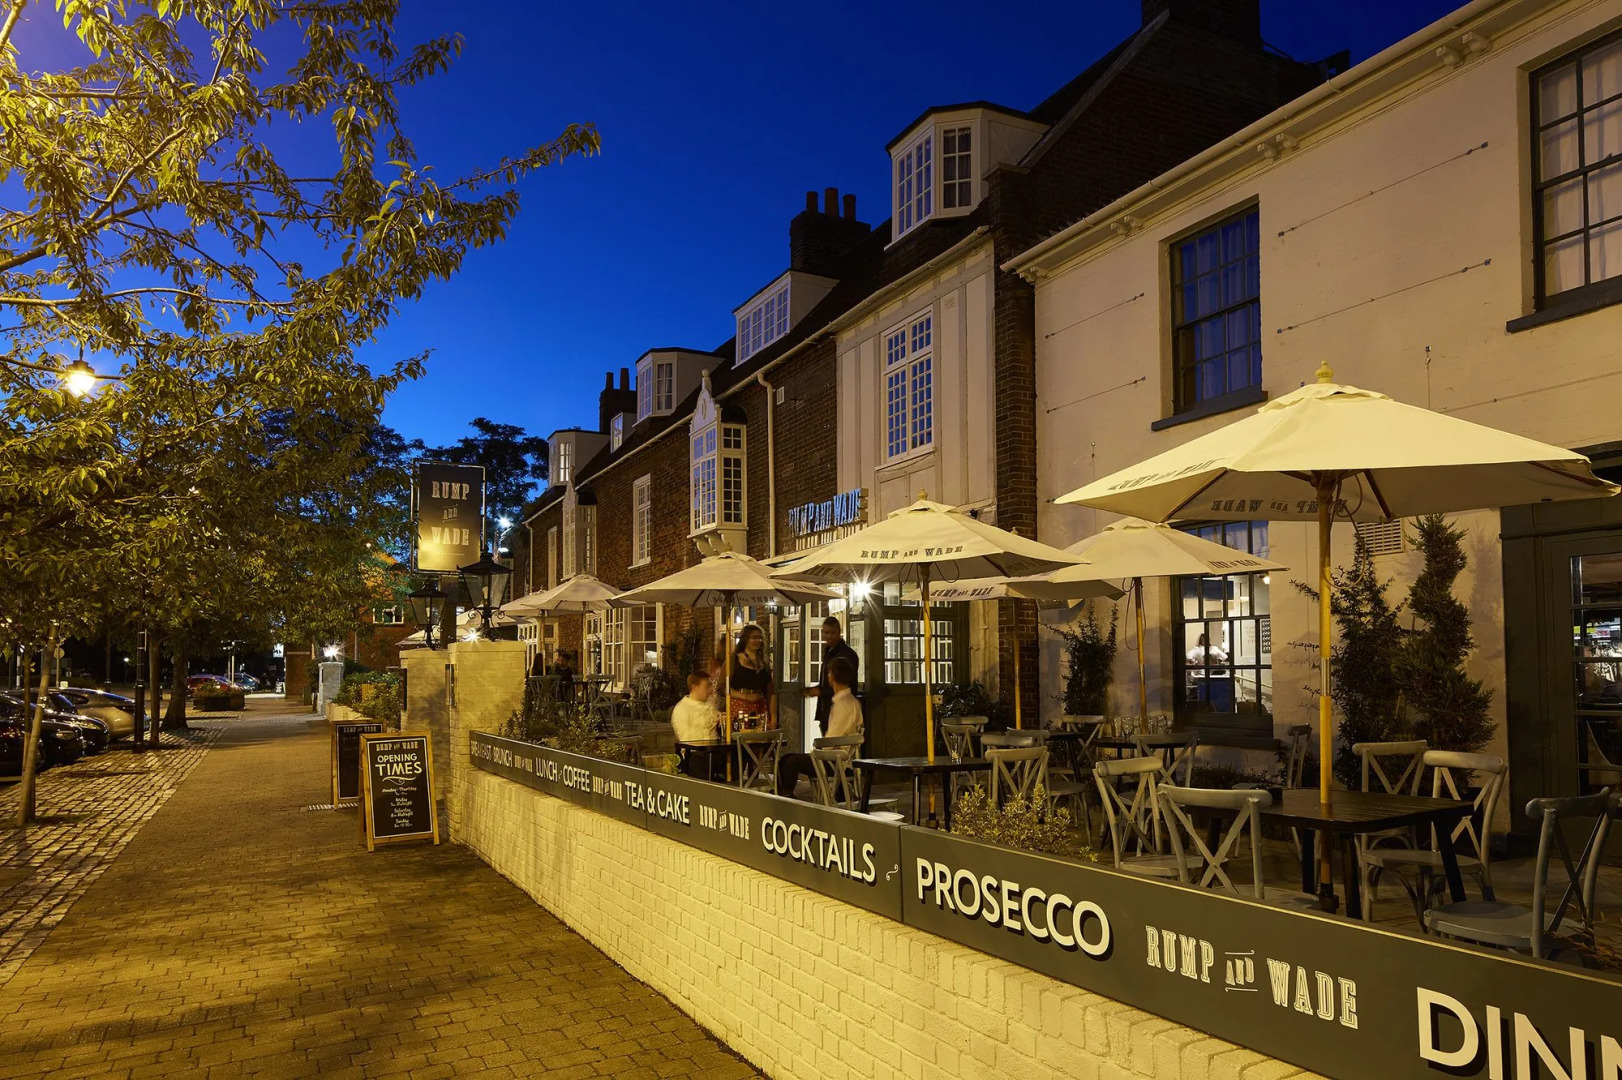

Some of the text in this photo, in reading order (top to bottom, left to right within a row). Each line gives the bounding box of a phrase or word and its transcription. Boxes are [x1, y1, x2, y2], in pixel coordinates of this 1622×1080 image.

[431, 480, 470, 500] RUMP
[442, 507, 458, 520] AND
[814, 500, 832, 532] AND
[833, 487, 862, 527] WADE
[430, 526, 470, 546] WADE
[860, 550, 900, 559] RUMP
[925, 545, 964, 557] WADE
[376, 743, 393, 751] RUMP
[402, 741, 418, 749] WADE
[377, 753, 418, 763] OPENING
[374, 761, 422, 776] TIMES
[493, 746, 513, 768] BRUNCH
[535, 757, 558, 782] LUNCH
[562, 764, 591, 793] COFFEE
[624, 780, 646, 811] TEA
[647, 786, 656, 815] &
[657, 789, 691, 825] CAKE
[699, 804, 718, 830] RUMP
[728, 812, 750, 840] WADE
[761, 816, 877, 884] COCKTAILS
[916, 856, 1111, 957] PROSECCO
[1145, 925, 1215, 984] RUMP
[1224, 956, 1256, 987] AND
[1266, 957, 1359, 1030] WADE
[1416, 986, 1622, 1080] DIN
